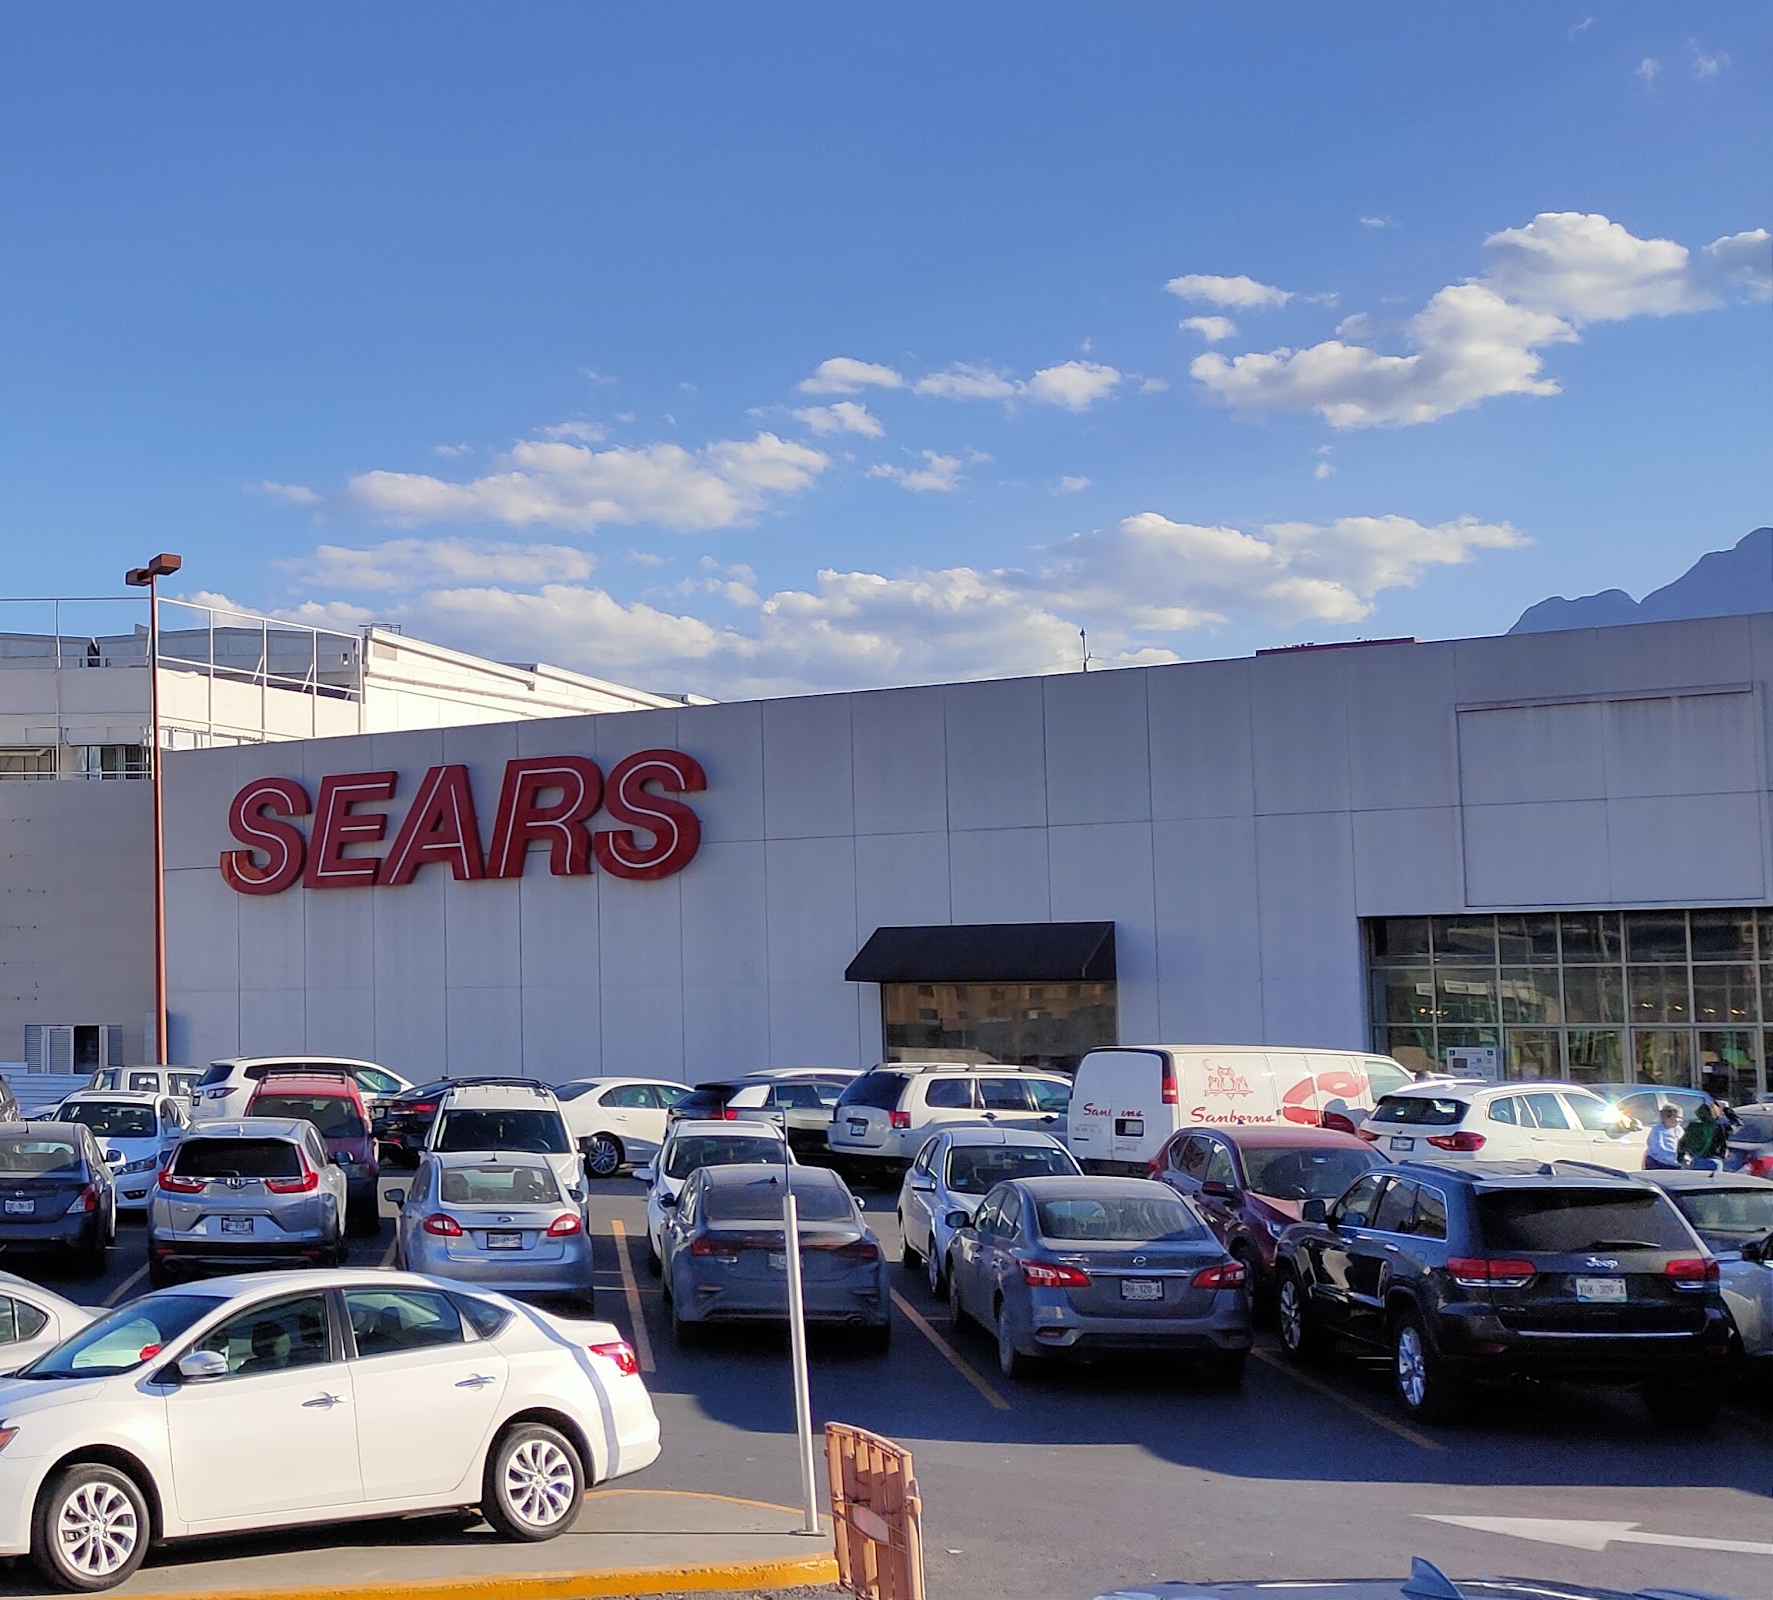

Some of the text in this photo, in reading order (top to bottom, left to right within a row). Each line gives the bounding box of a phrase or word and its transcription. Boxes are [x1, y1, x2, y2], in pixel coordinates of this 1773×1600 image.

[220, 748, 707, 895] SEARS
[1191, 1106, 1276, 1123] Sanborns
[1586, 1256, 1619, 1269] Jeep
